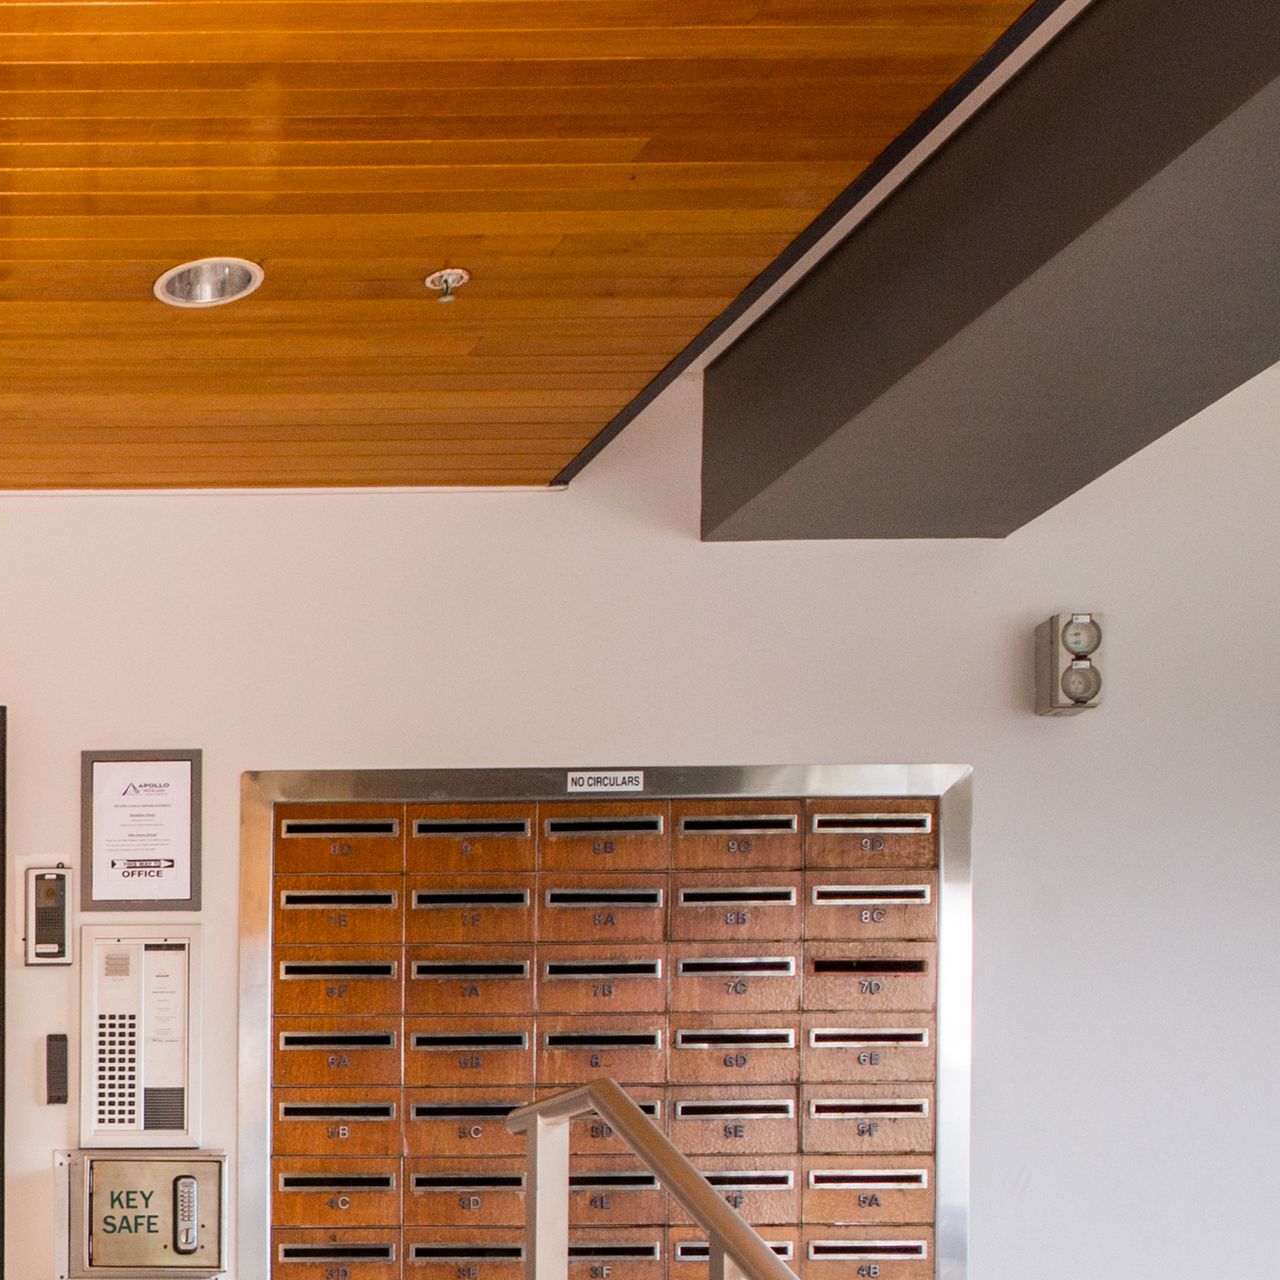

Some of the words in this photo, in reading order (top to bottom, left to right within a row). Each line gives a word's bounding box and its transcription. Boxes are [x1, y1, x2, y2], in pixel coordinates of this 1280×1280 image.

[570, 776, 585, 787] NO
[586, 775, 641, 787] CIRCULARS
[594, 842, 614, 854] 9B
[728, 841, 751, 852] 9C
[861, 839, 885, 851] 9D
[122, 869, 164, 878] OFFICE
[594, 912, 616, 925] 8A
[726, 912, 747, 924] 8B
[861, 909, 885, 922] 8C
[593, 984, 613, 996] 7B
[725, 982, 747, 994] 7C
[860, 981, 883, 993] 7D
[328, 1055, 350, 1068] 6A
[460, 1056, 481, 1068] 6B
[724, 1055, 747, 1067] 6D
[859, 1052, 879, 1064] 6E
[591, 1125, 614, 1137] 5D
[724, 1124, 744, 1137] 5E
[857, 1123, 878, 1135] 5F
[110, 1190, 154, 1209] KEY
[459, 1197, 481, 1209] 4D
[858, 1195, 880, 1207] 5A
[102, 1215, 159, 1234] SAFE
[591, 1266, 612, 1278] 3F
[857, 1265, 879, 1277] 4B
